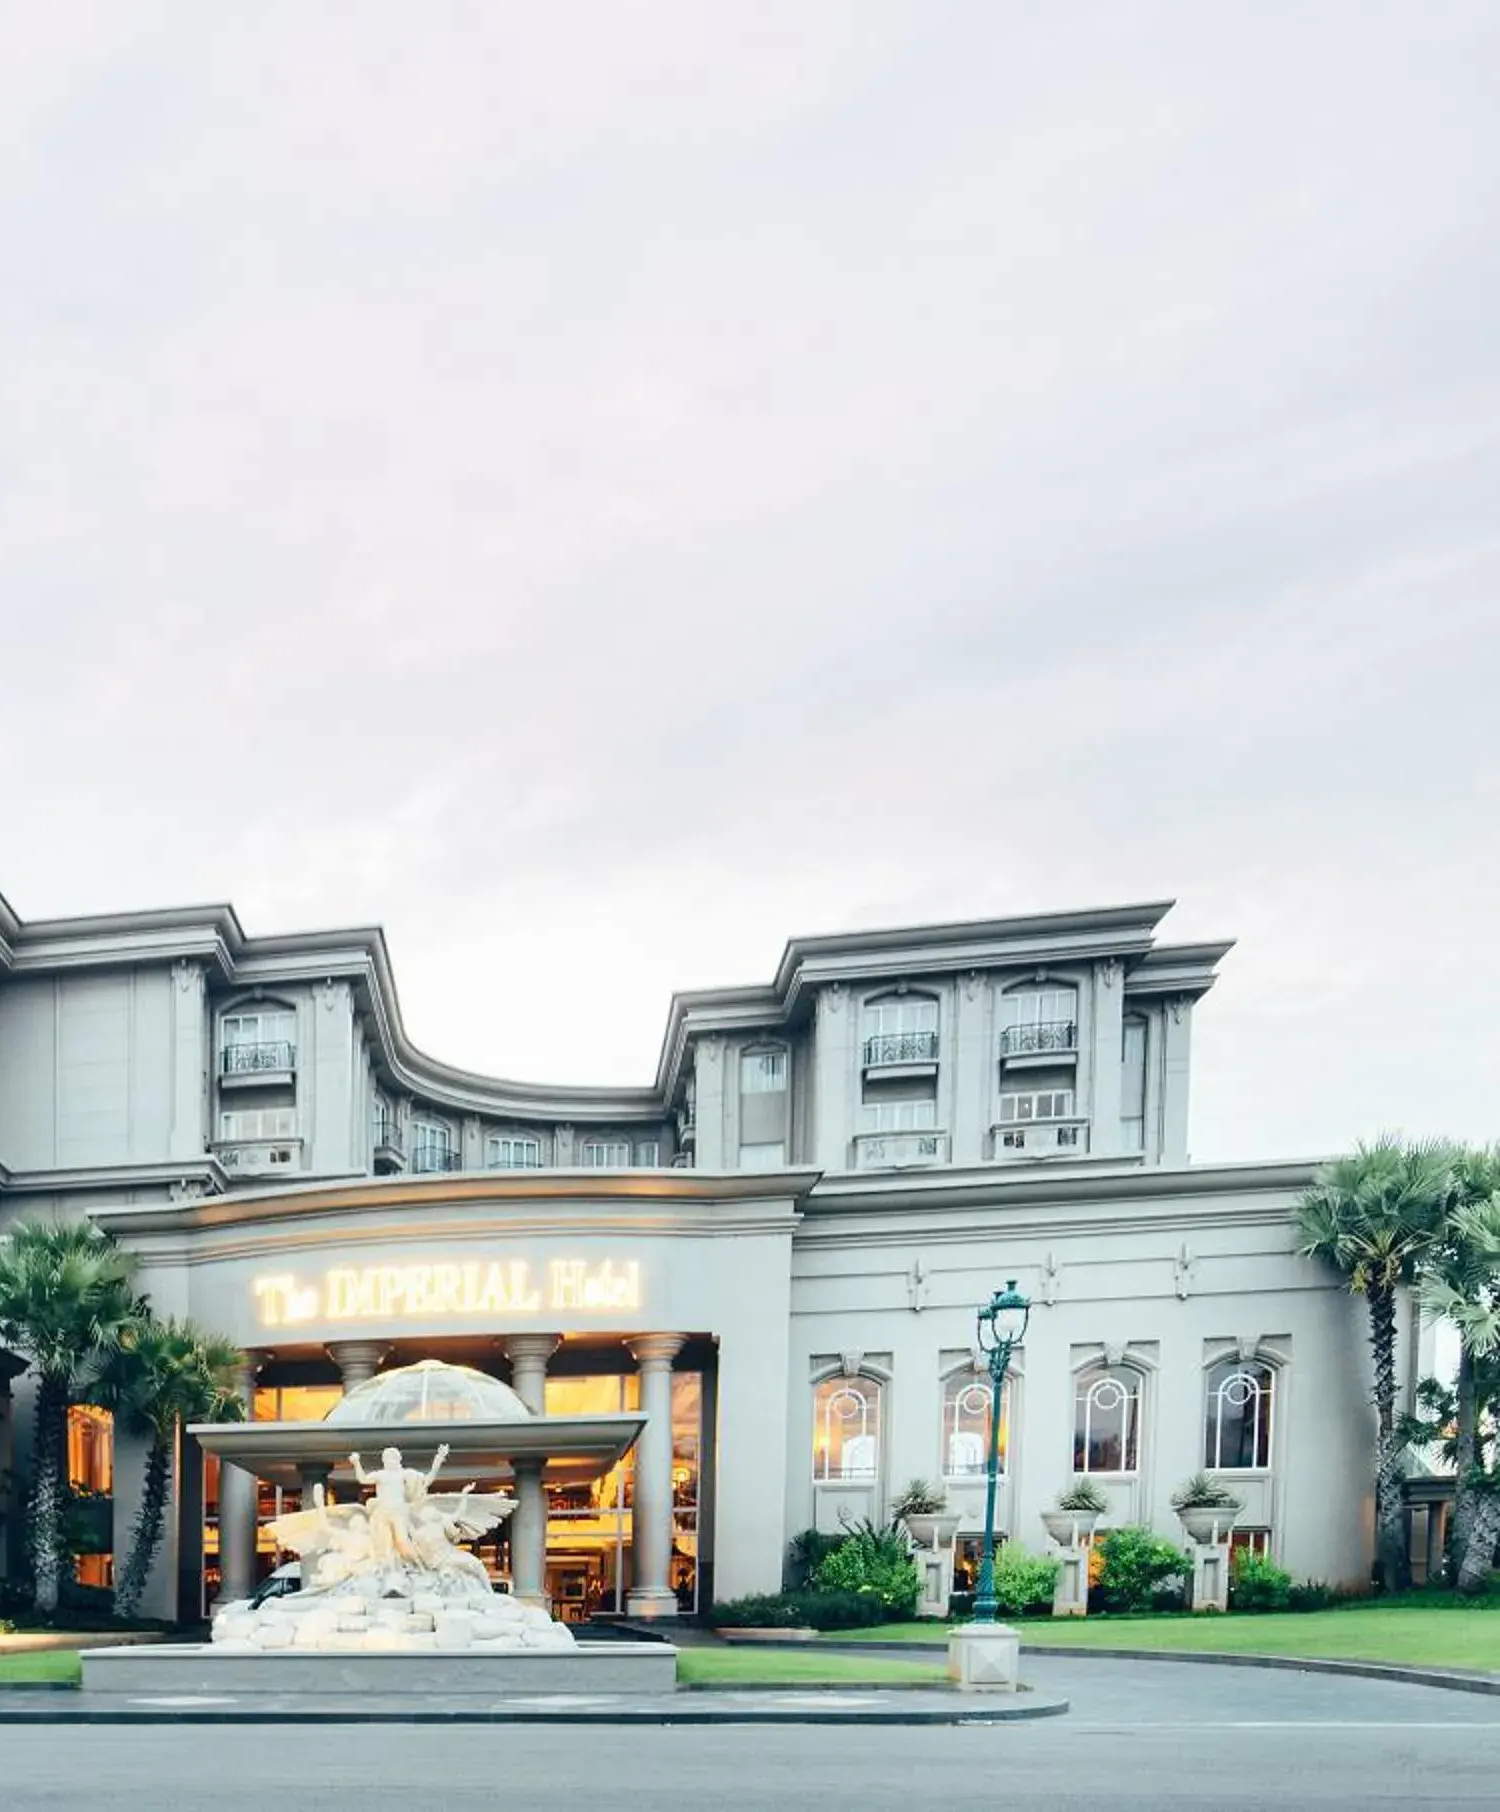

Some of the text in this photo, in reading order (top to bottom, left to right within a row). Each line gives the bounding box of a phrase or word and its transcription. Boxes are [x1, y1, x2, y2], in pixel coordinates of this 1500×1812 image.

[255, 1258, 641, 1326] The IMPERIAL Hotel
